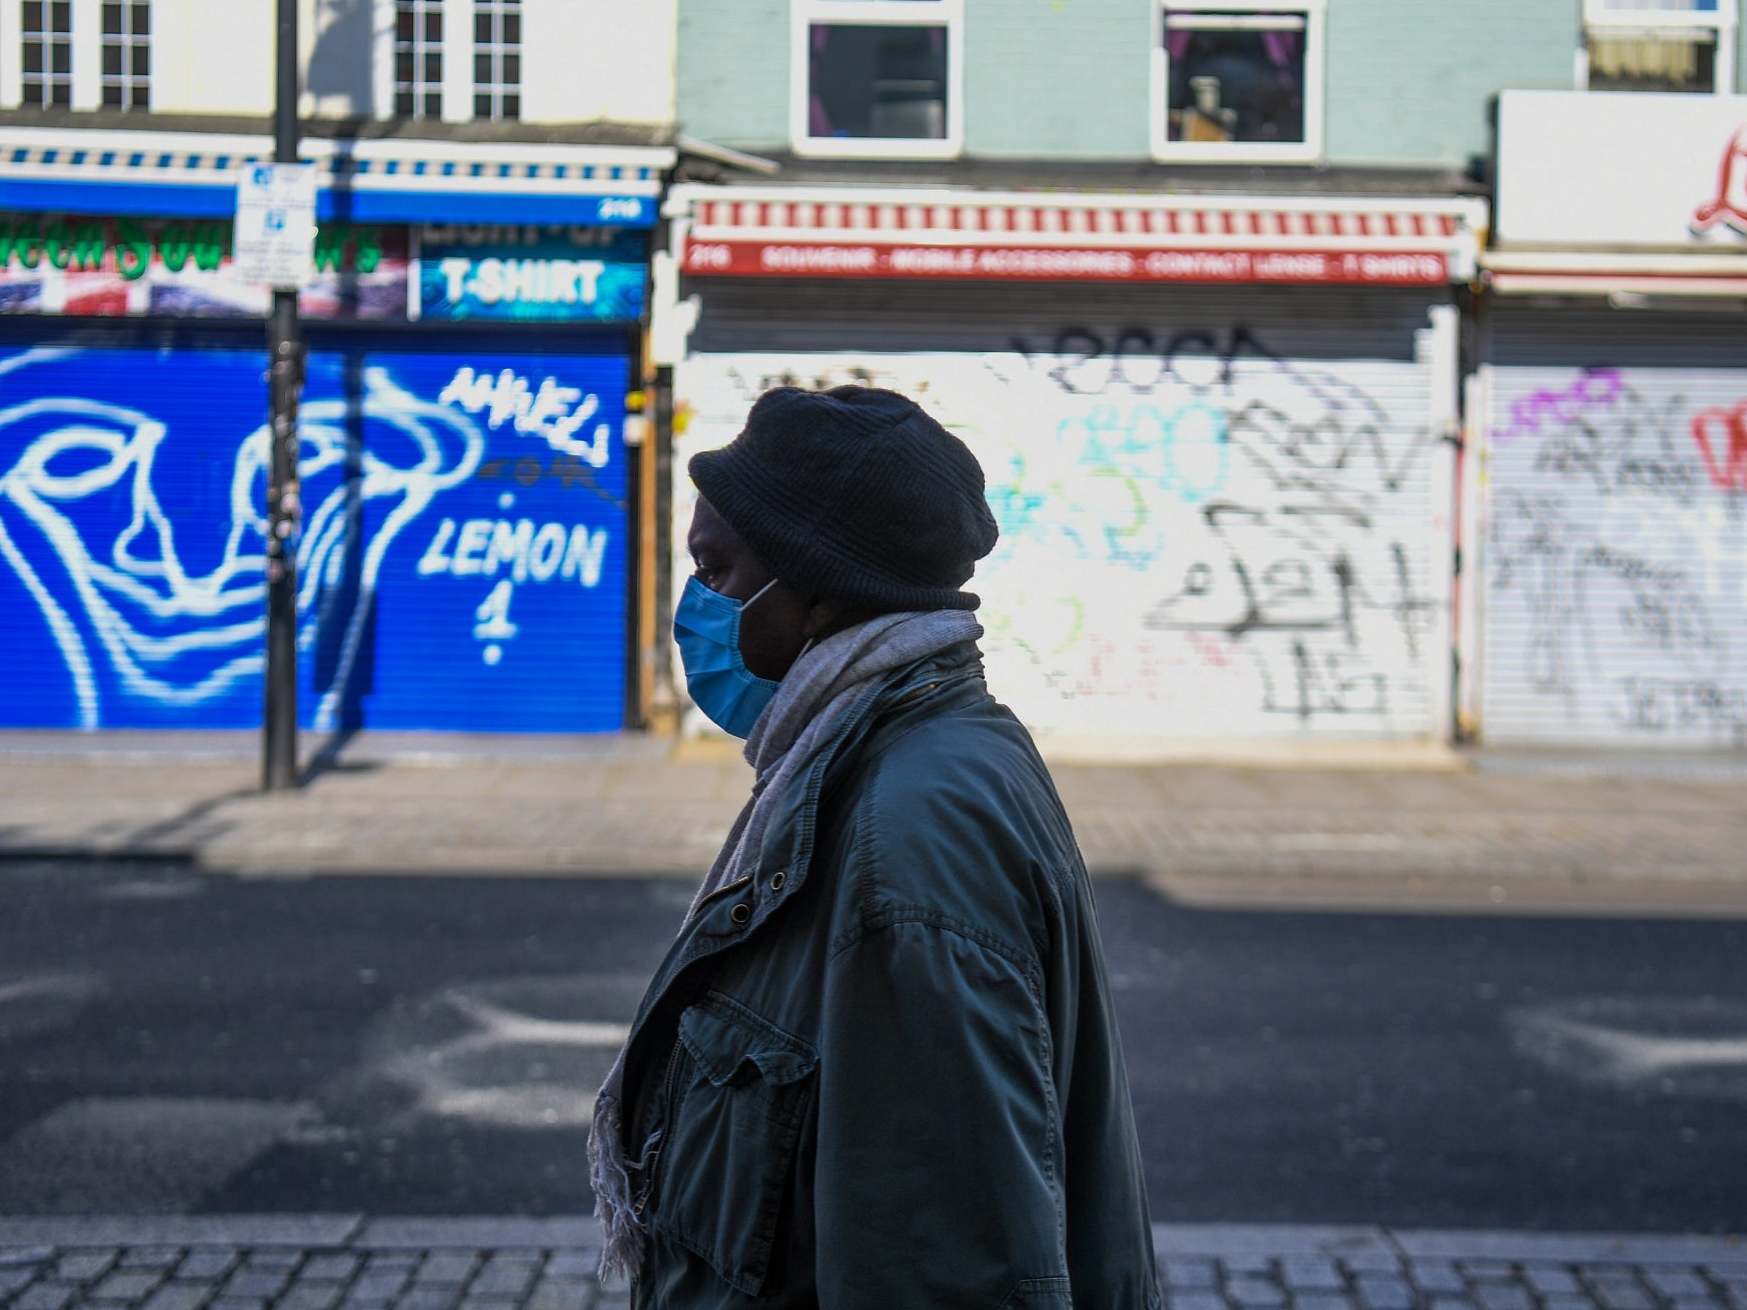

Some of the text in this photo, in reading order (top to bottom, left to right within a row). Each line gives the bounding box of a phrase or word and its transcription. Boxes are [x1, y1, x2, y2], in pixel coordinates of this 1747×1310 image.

[440, 257, 605, 304] T-SHIRT
[689, 244, 731, 270] 216
[761, 245, 877, 272] SOUVENIR
[890, 247, 975, 274] MOBILE
[979, 248, 1135, 276] ACCESSORIES
[1146, 251, 1250, 279] CONTACT
[417, 516, 607, 588] LEMON
